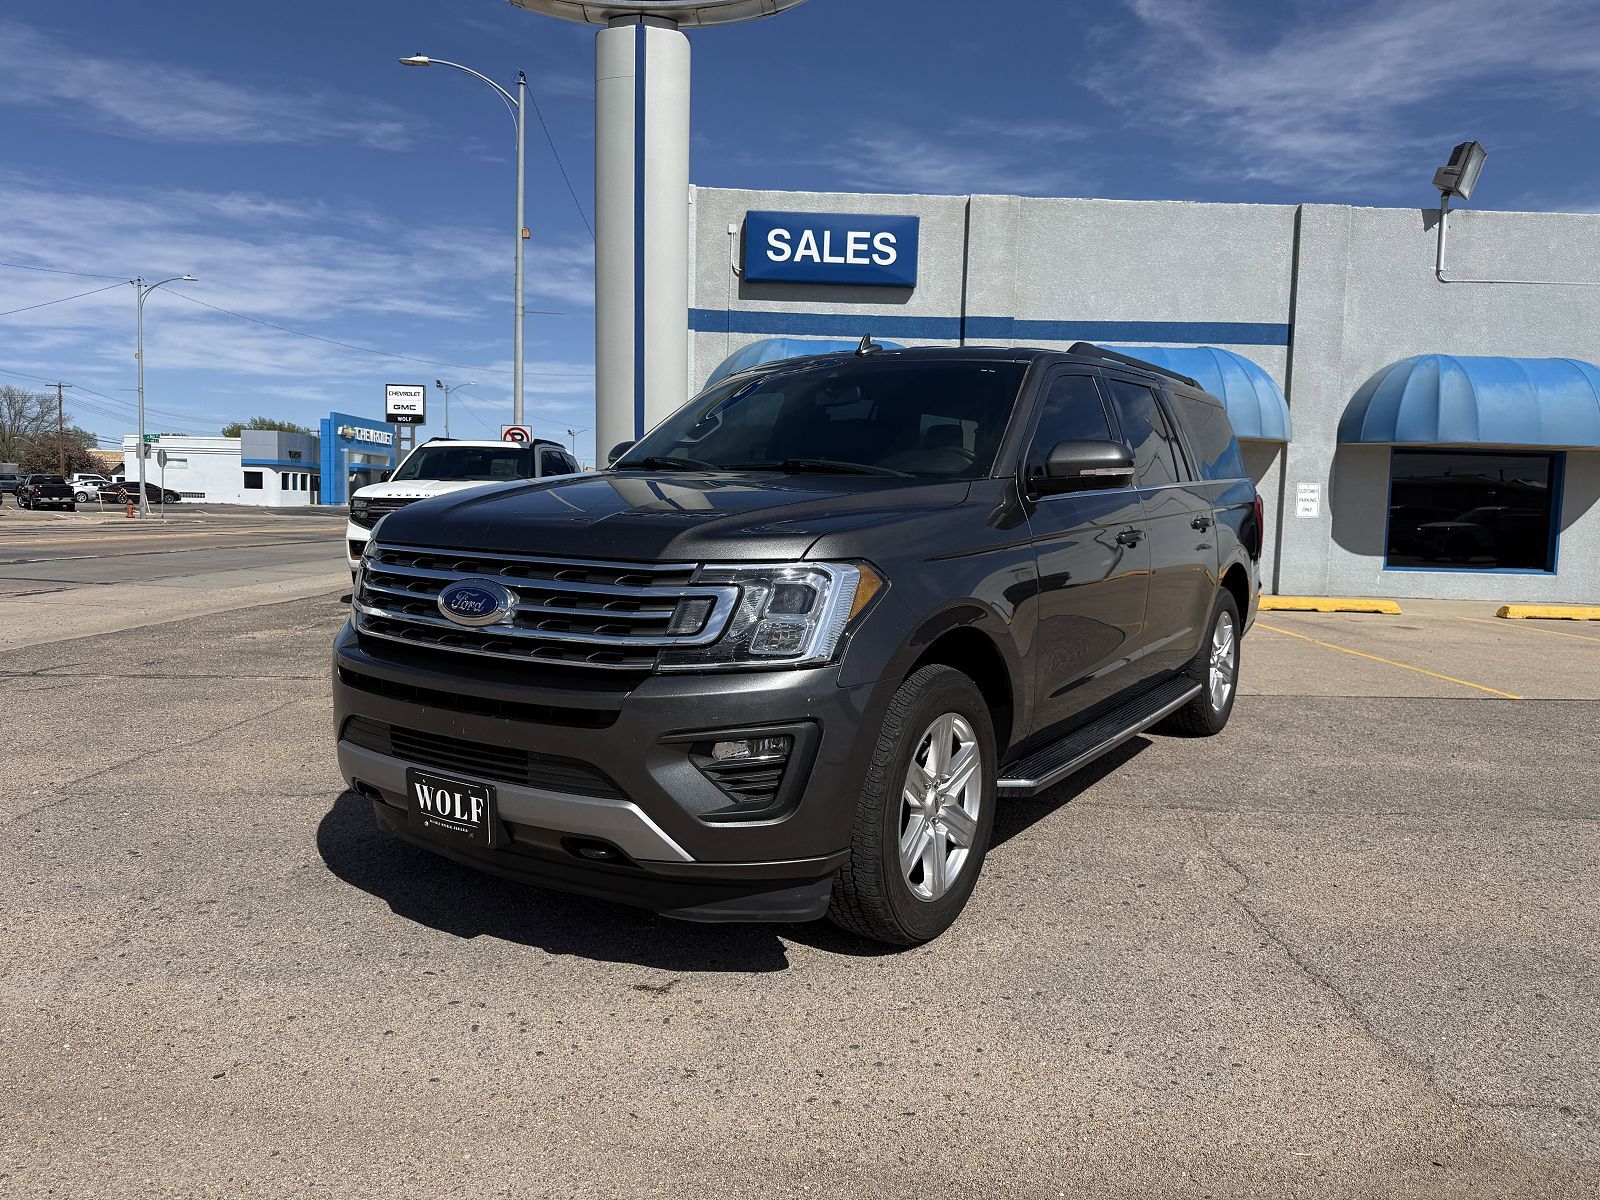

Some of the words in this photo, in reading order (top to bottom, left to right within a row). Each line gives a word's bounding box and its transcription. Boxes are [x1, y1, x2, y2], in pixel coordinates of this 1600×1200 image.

[766, 228, 897, 266] SALES
[451, 591, 487, 612] Ford
[414, 783, 483, 823] WOLF
